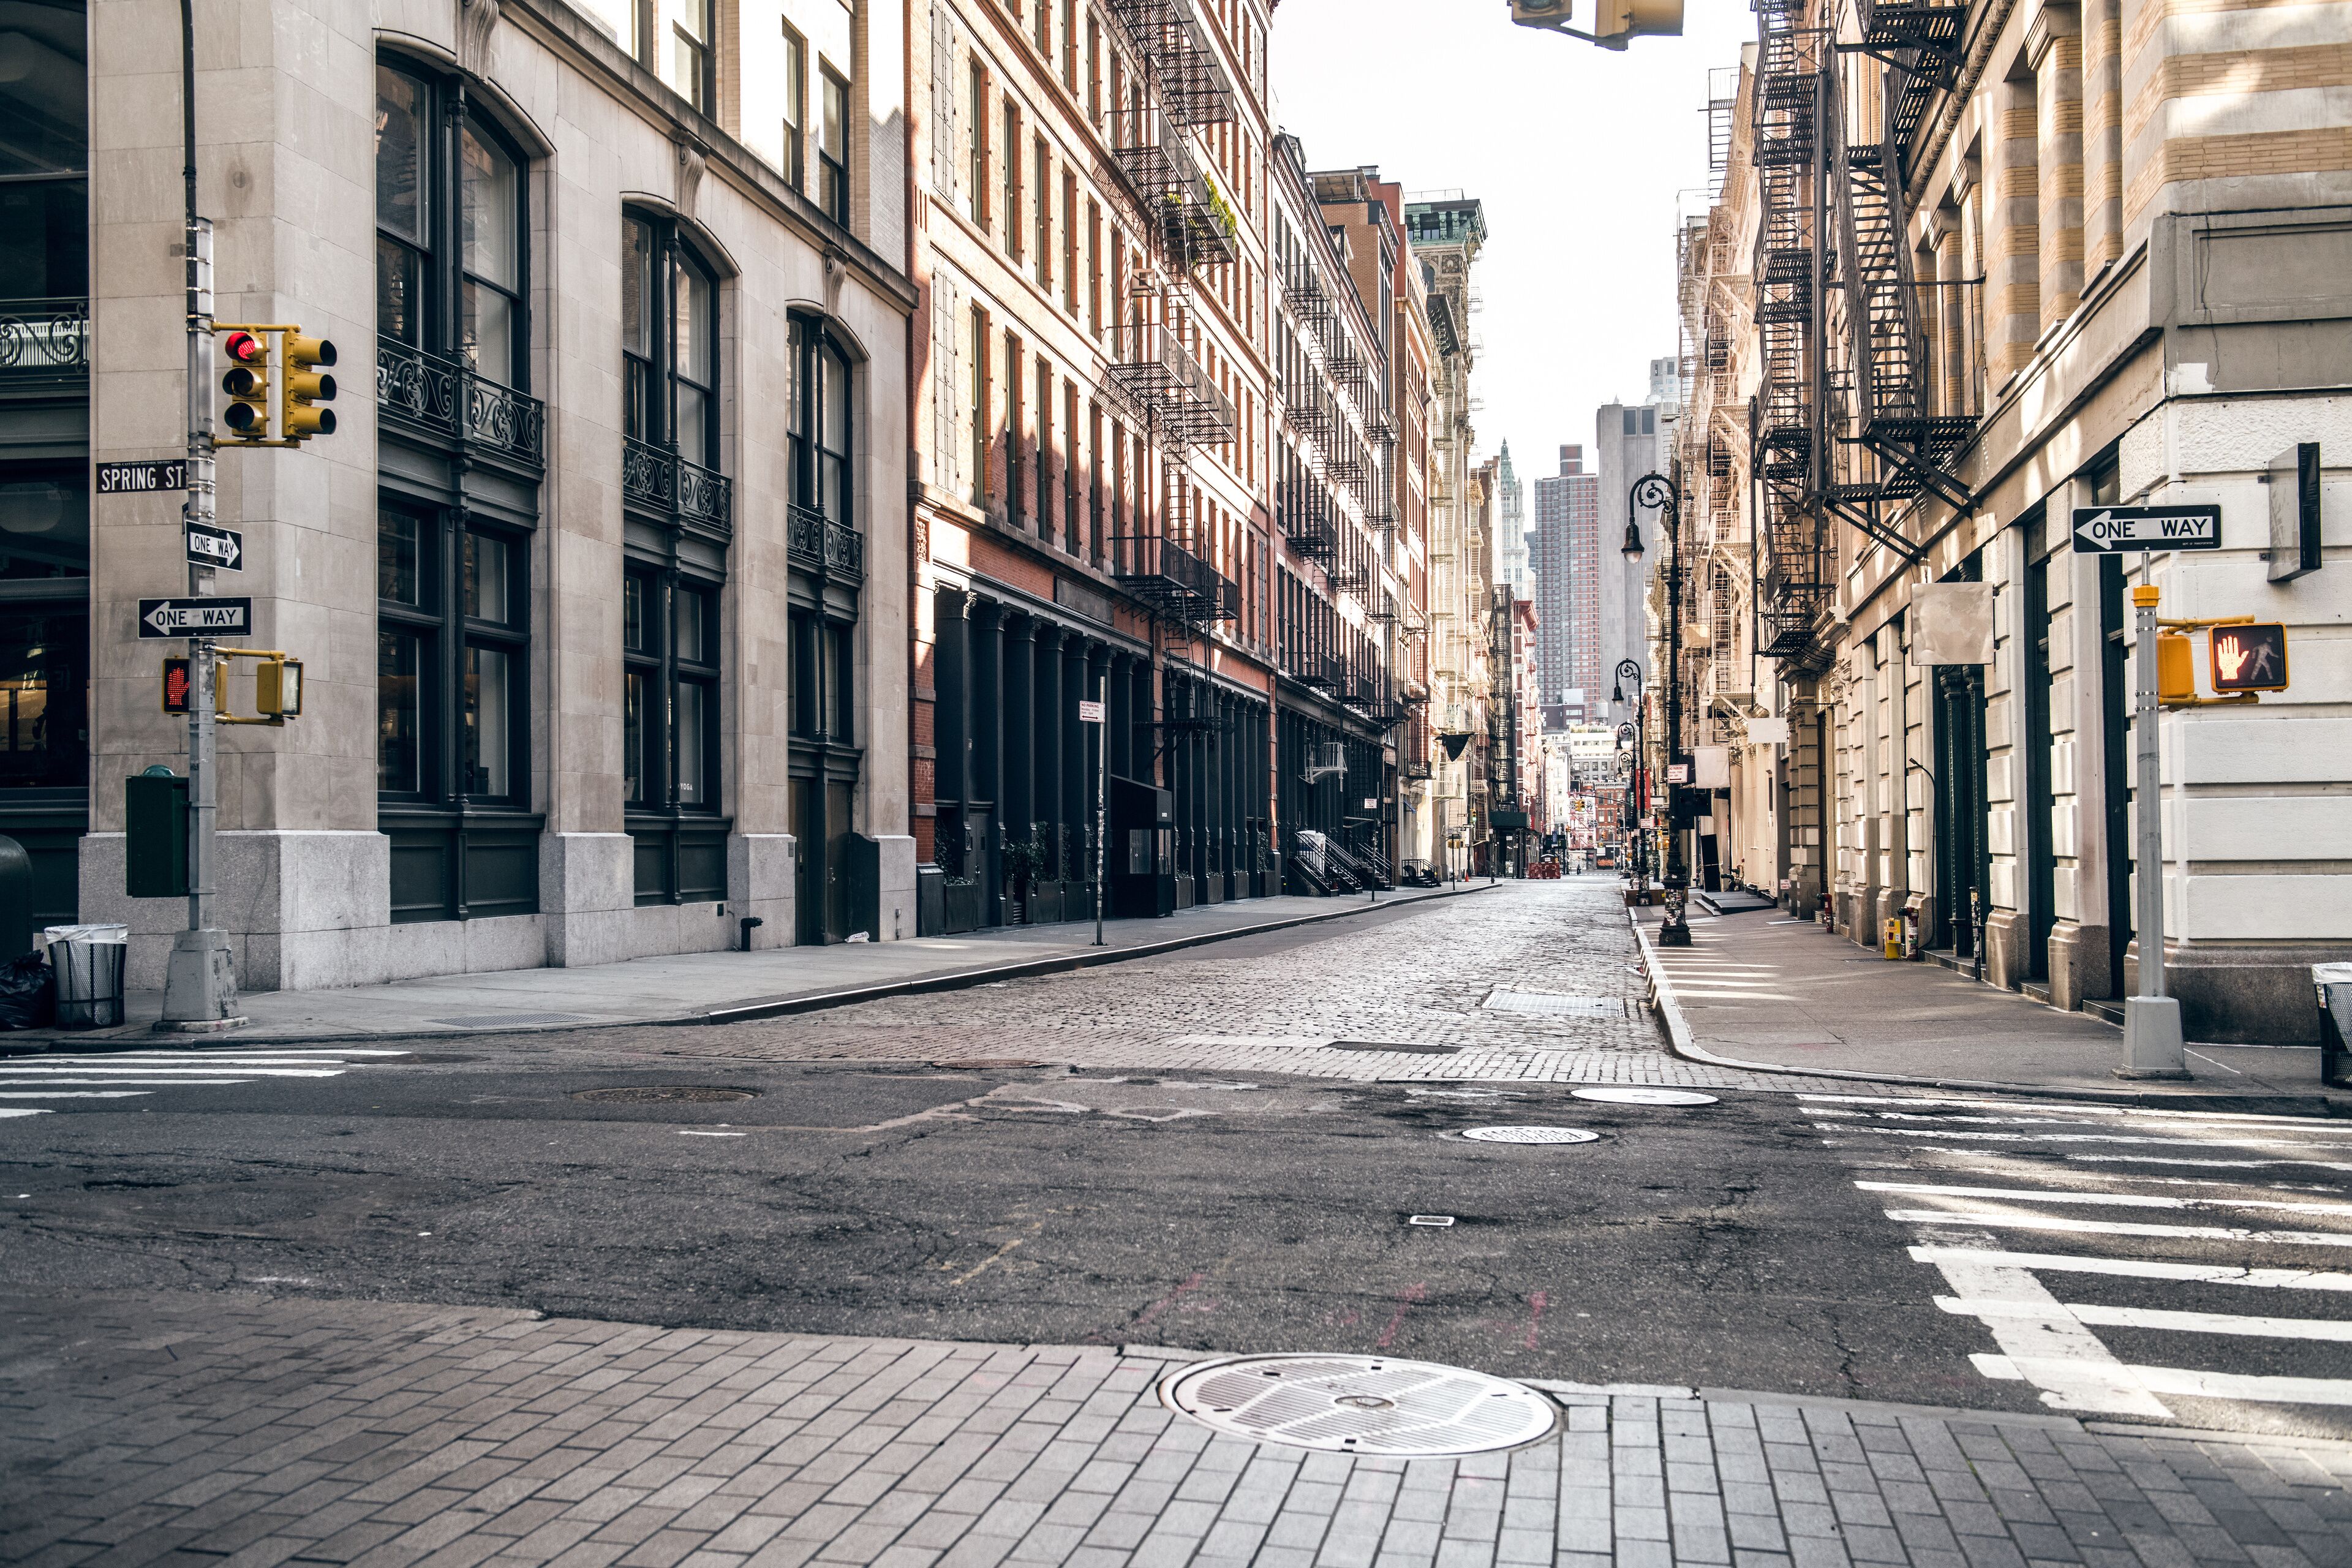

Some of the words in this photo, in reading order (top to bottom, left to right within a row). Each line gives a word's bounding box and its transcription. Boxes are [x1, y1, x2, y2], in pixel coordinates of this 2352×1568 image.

[101, 467, 156, 491] SPRING
[165, 466, 184, 488] ST
[2092, 521, 2136, 539] ONE
[2160, 518, 2208, 537] WAY
[194, 535, 211, 553] ONE
[217, 540, 234, 558] WAY
[156, 610, 187, 626] ONE
[203, 609, 236, 625] WAY
